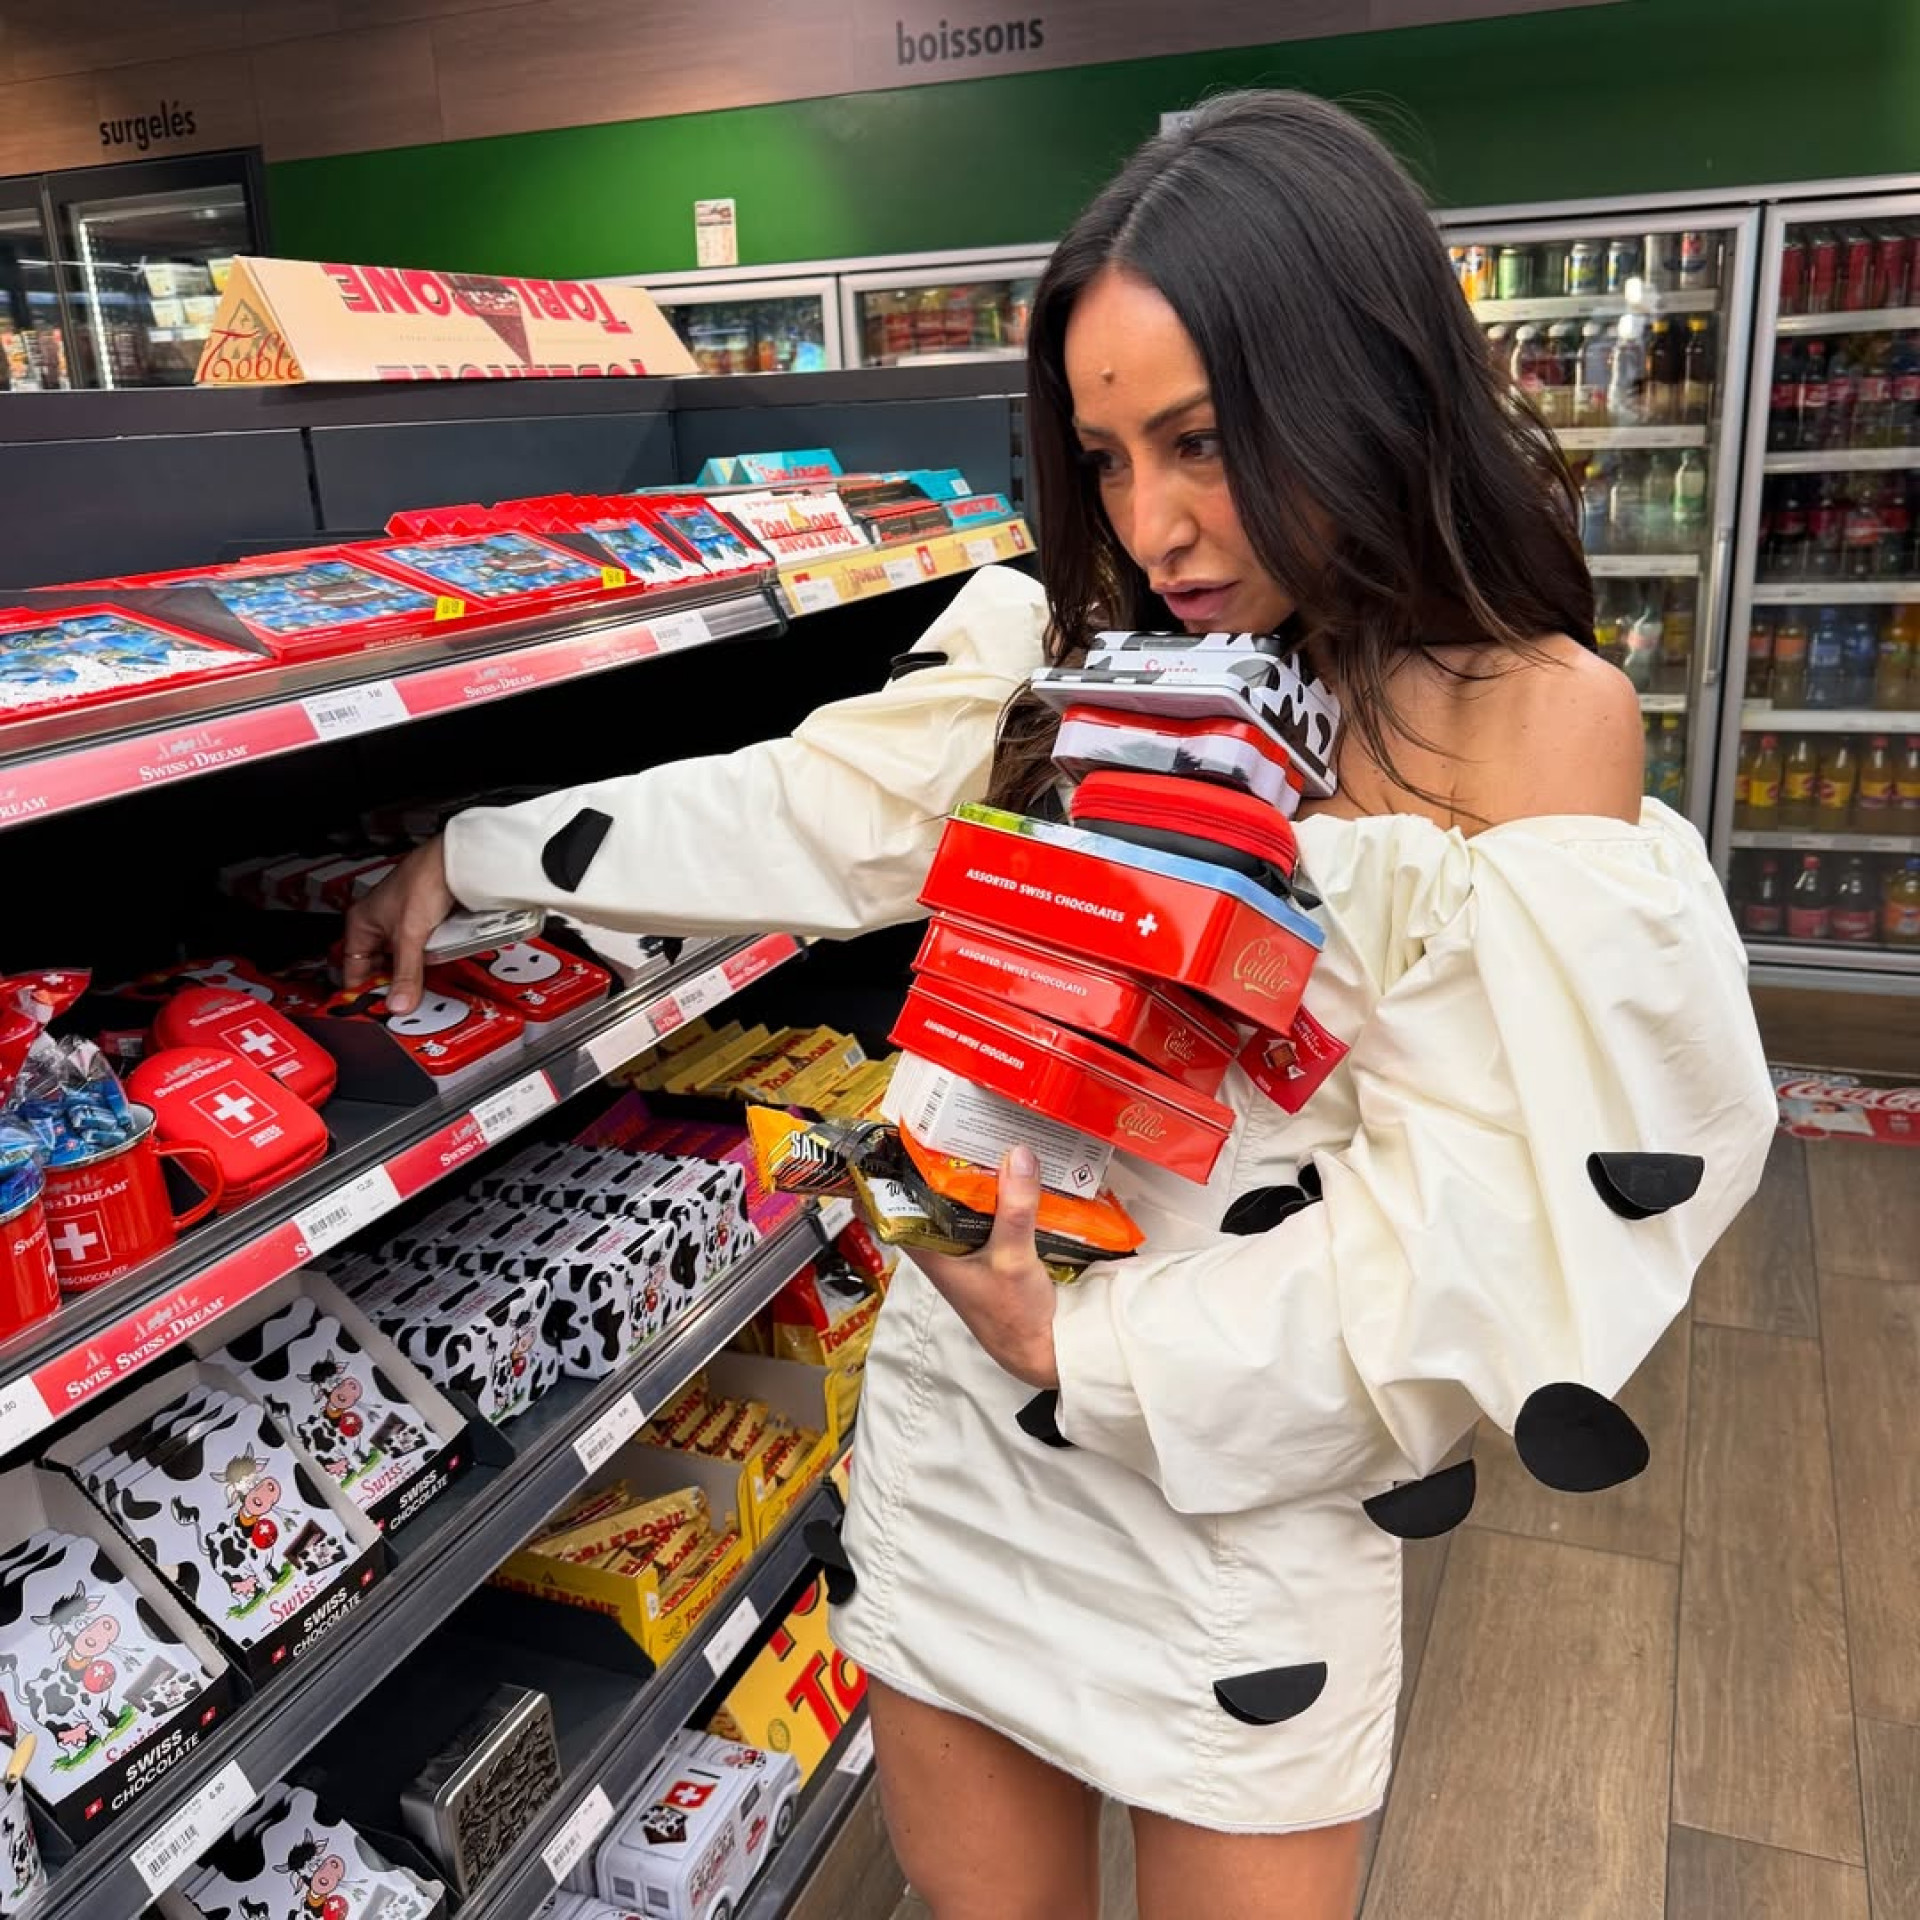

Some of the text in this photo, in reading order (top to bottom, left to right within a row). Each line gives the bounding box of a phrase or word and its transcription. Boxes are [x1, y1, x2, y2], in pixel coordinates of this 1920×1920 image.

[896, 18, 1043, 66] boissons
[100, 101, 196, 150] surgelés
[965, 868, 1126, 923] ASSORTED SWISS CHOCOLATES
[957, 947, 1088, 997] ASSORTED SWISS CHOCOLATES
[115, 1337, 166, 1371] SWISS
[168, 1297, 225, 1338] DREAM
[360, 1461, 404, 1500] Swiss
[390, 1473, 448, 1531] CHOCOLATE
[399, 1468, 438, 1509] SWISS
[269, 1580, 317, 1624] Swiss
[292, 1590, 361, 1657] CHOCOLATE
[303, 1586, 348, 1633] SWISS
[111, 1731, 200, 1811] CHOCOLATE
[125, 1728, 183, 1783] SWISS
